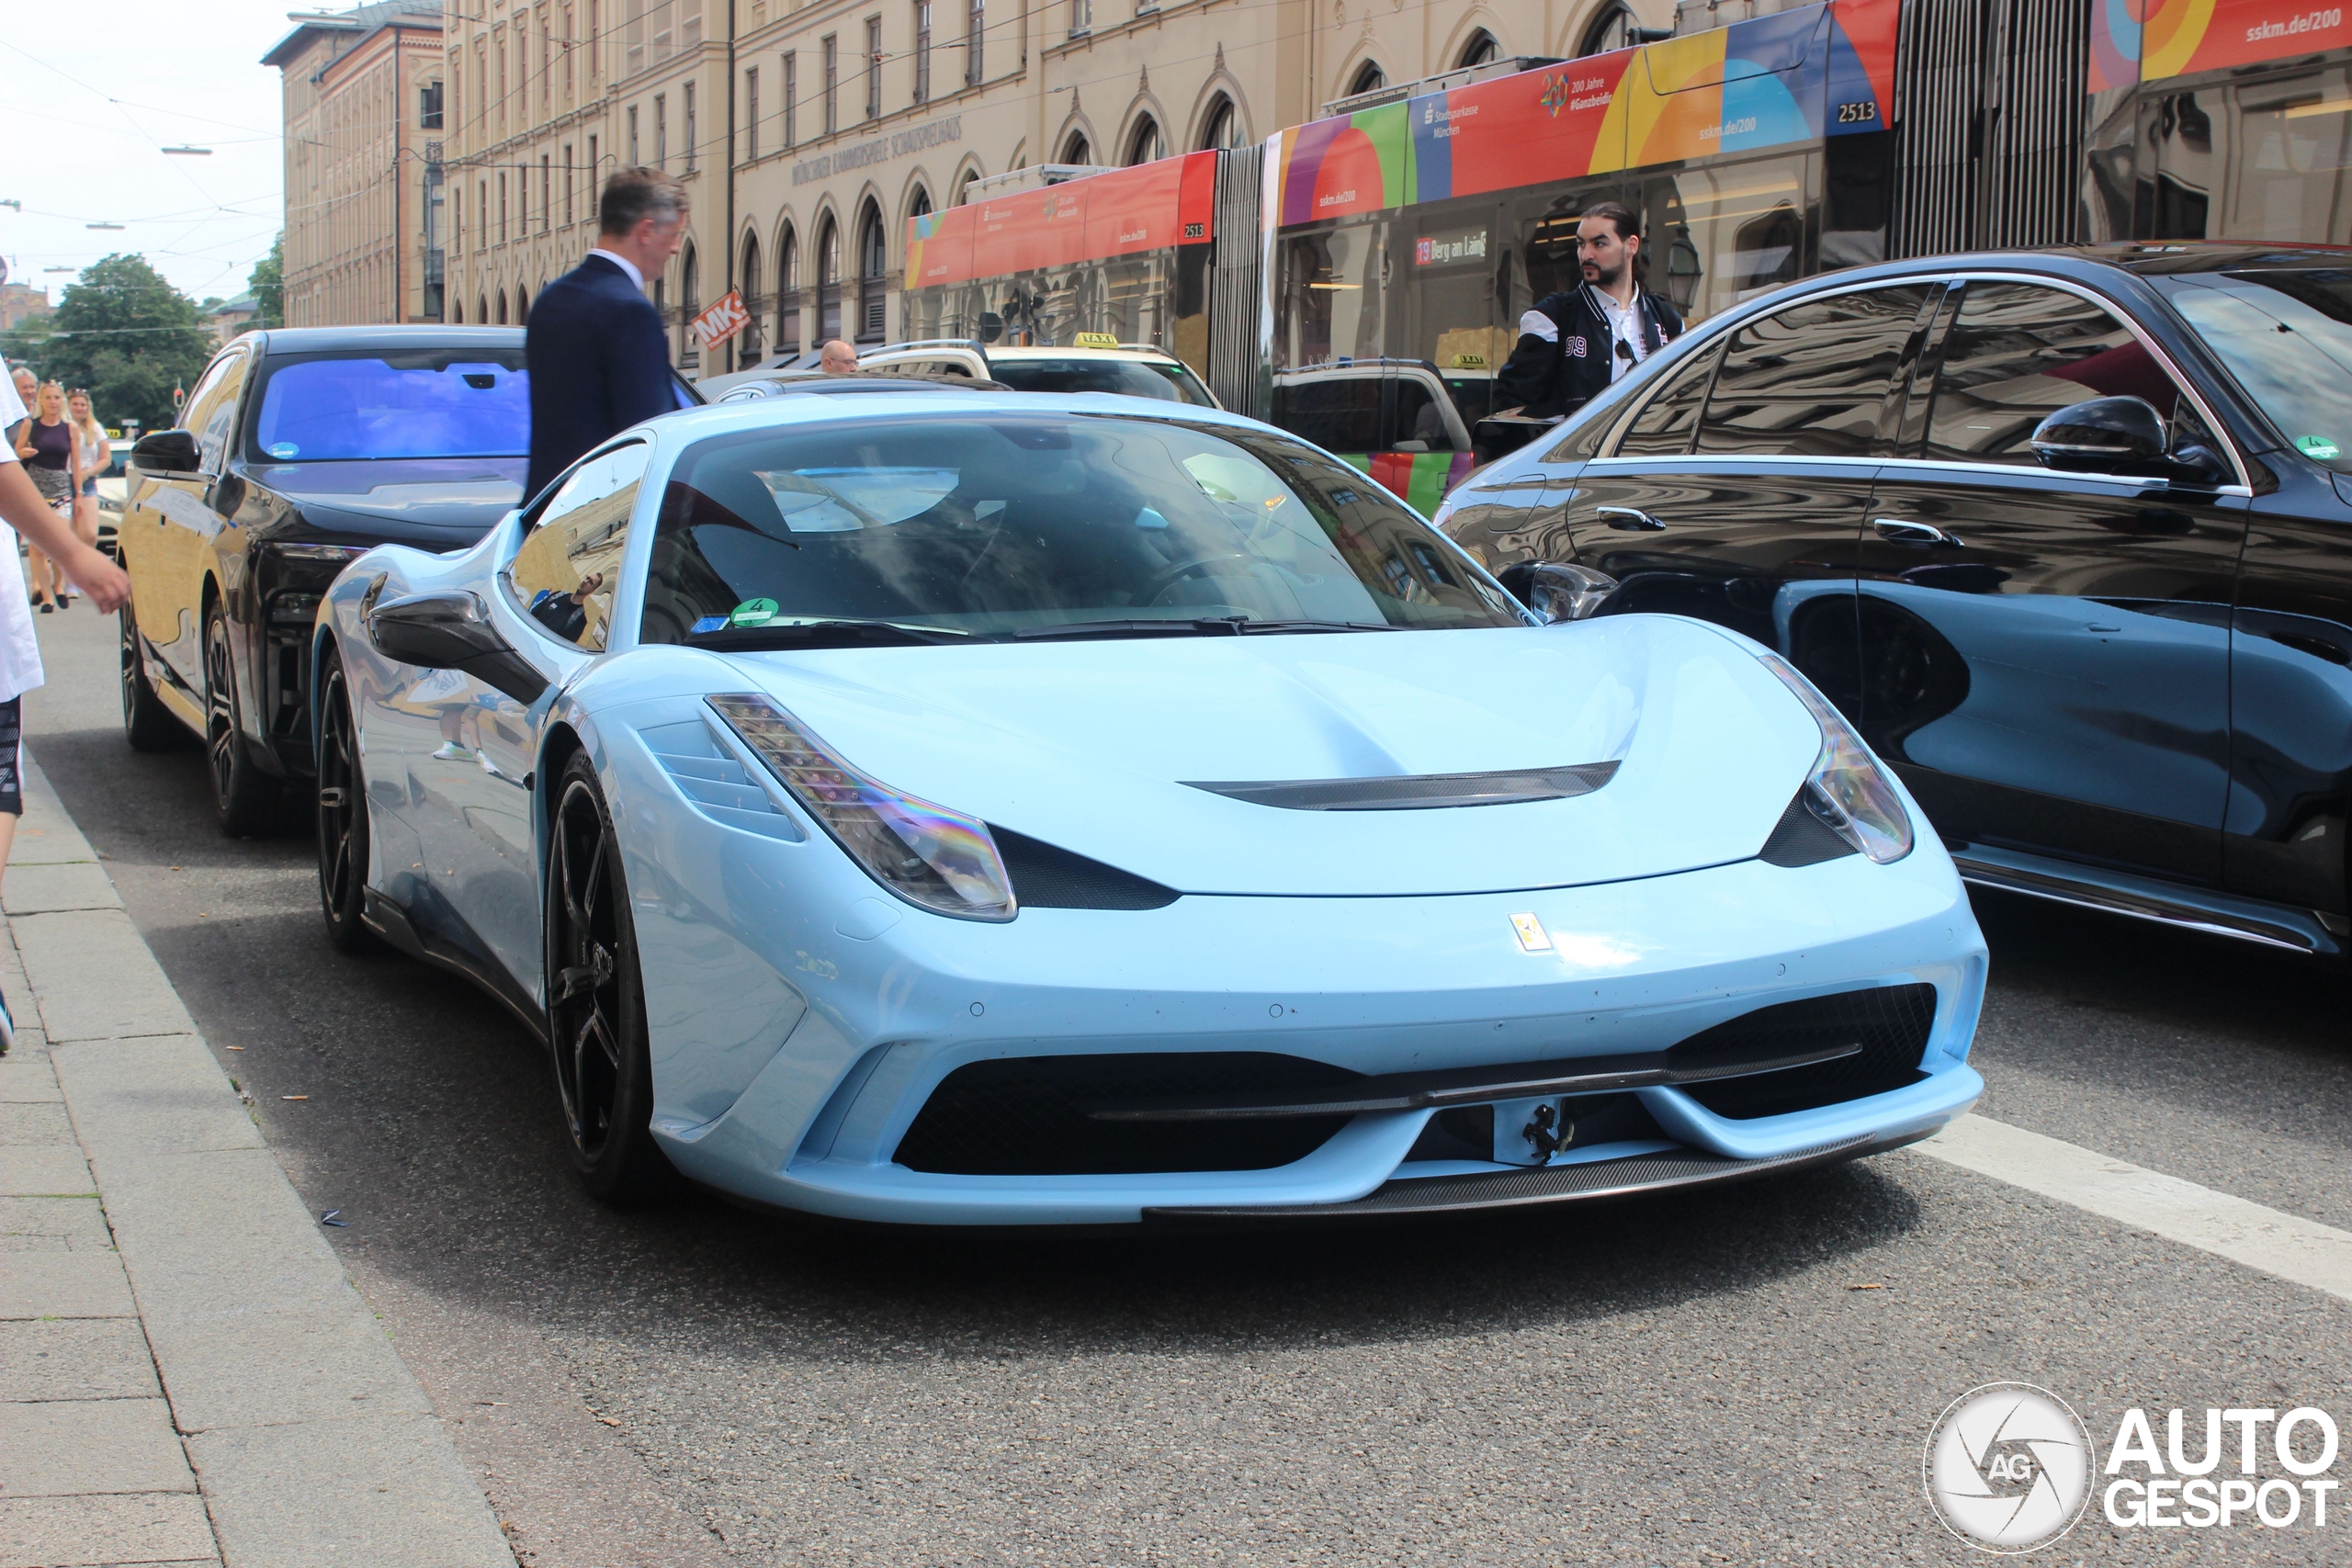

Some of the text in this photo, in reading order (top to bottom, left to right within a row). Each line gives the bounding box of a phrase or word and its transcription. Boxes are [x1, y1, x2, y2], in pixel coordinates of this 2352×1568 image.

[2246, 7, 2342, 42] sskm.de/200
[1571, 77, 1604, 94] 200 Jahre
[1434, 104, 1478, 122] Stadtsparkasse
[1838, 101, 1875, 123] 2513
[891, 115, 962, 158] SCHAUSPIELHAUS
[1433, 125, 1460, 139] München
[1700, 117, 1757, 140] sskm.de/200
[1319, 190, 1356, 207] sskm.de/200
[1119, 230, 1146, 243] sskm.de/200
[1184, 224, 1204, 238] 2513
[1418, 241, 1430, 262] 19
[1431, 240, 1450, 262] Berg
[694, 298, 748, 344] MK:
[1084, 334, 1114, 343] TAXI
[1565, 336, 1587, 357] 99
[750, 599, 763, 612] 4
